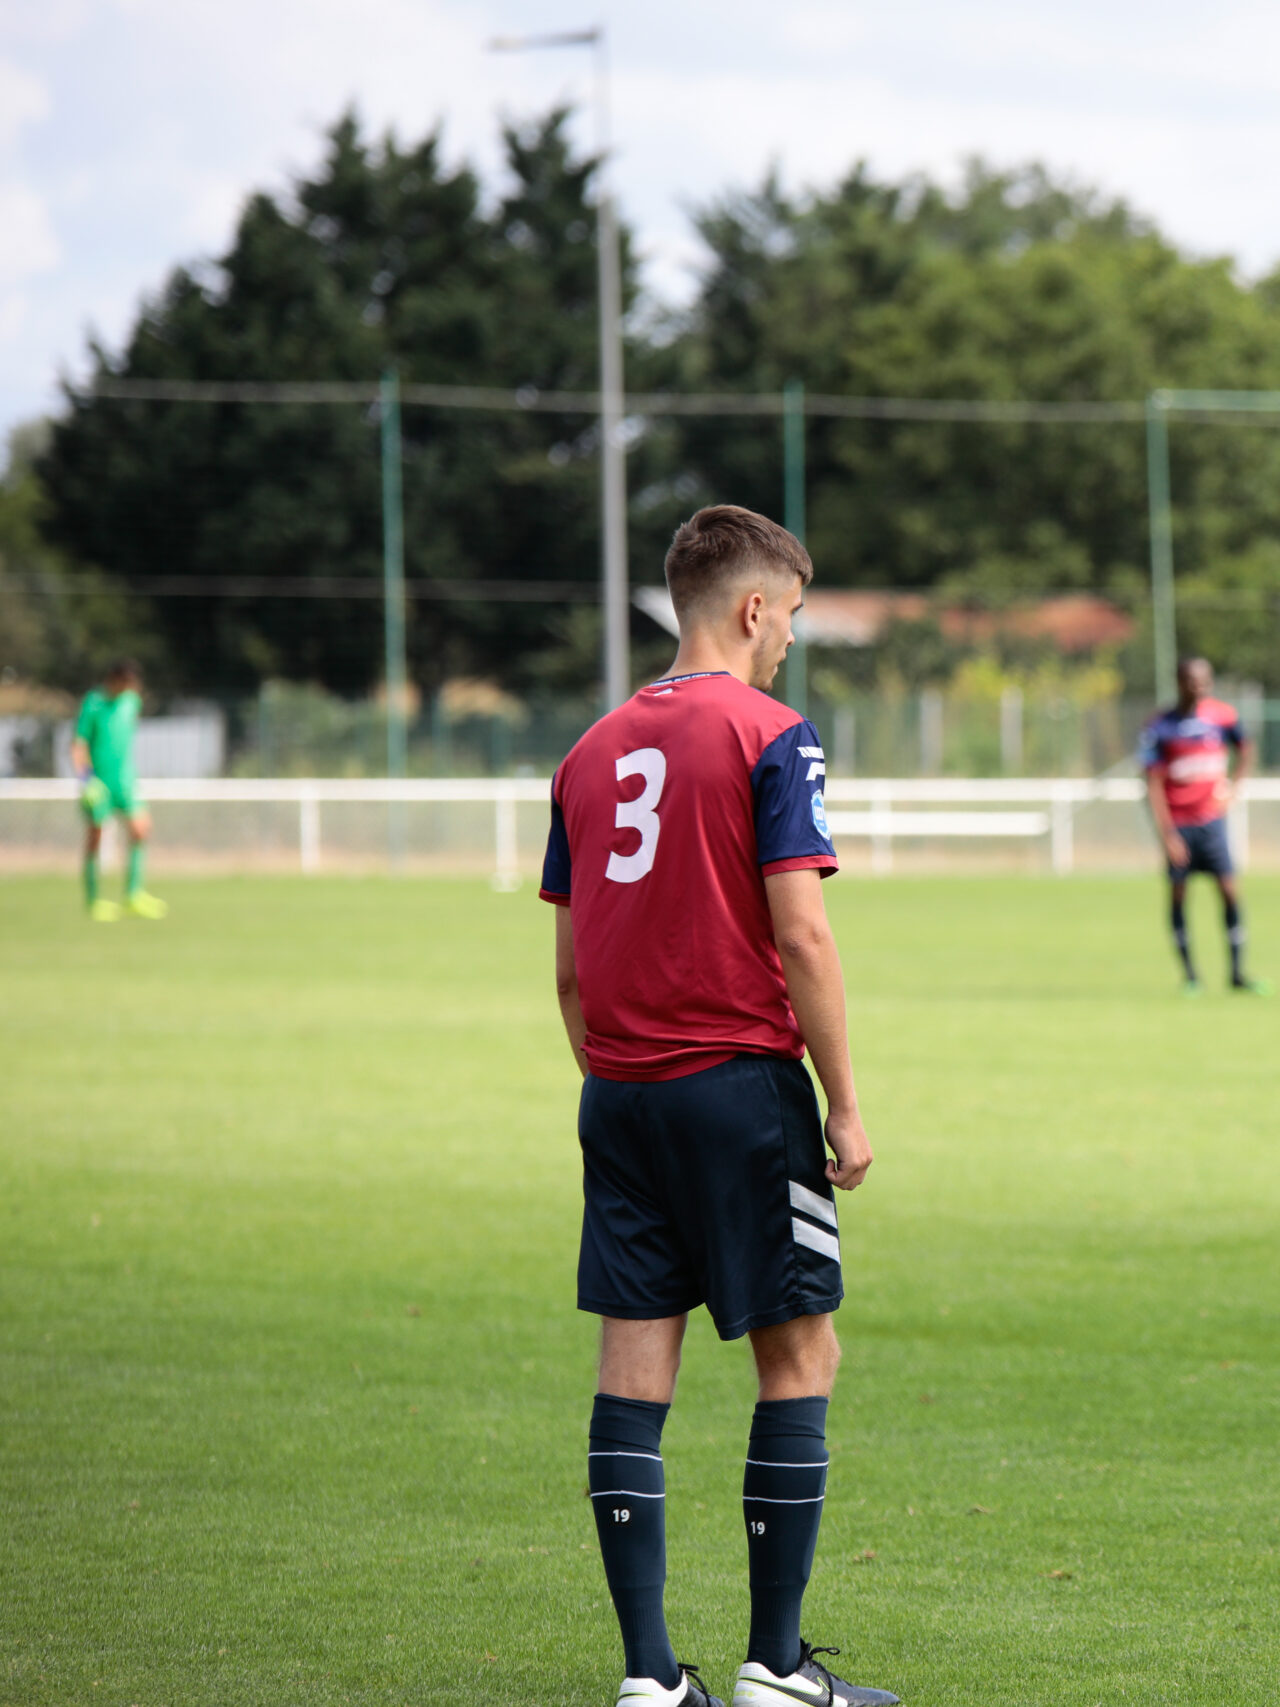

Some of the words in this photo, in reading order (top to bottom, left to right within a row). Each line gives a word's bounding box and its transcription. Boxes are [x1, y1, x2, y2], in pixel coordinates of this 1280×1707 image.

[605, 747, 667, 883] 3
[612, 1508, 630, 1523] 19
[750, 1521, 766, 1535] 19
